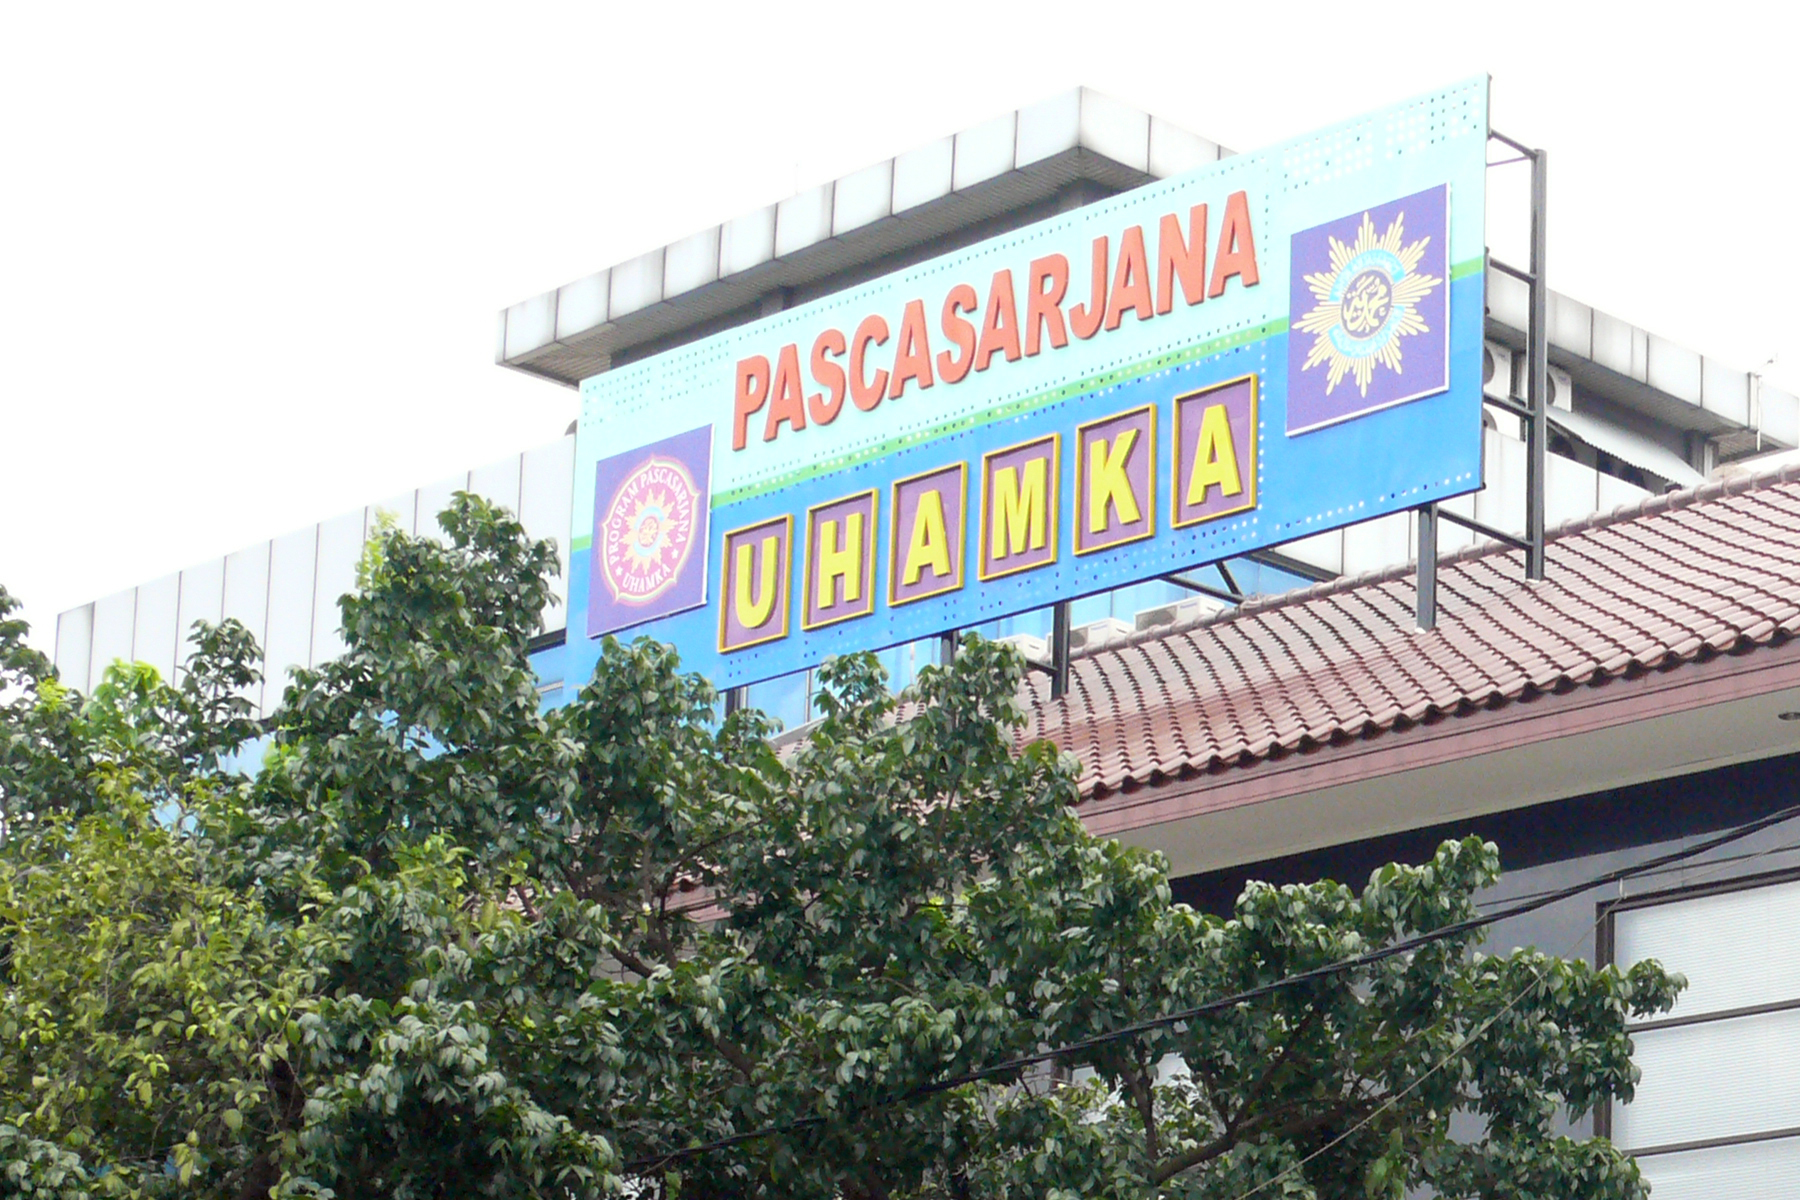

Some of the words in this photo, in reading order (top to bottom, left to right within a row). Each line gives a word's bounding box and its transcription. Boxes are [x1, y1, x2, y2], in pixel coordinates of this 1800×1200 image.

[732, 190, 1260, 451] PASCASARJANA
[608, 482, 639, 566] PROGRAM
[640, 468, 690, 544] PASCASARJANA
[622, 563, 671, 593] UHAMKA
[734, 403, 1242, 628] UHAMKA
